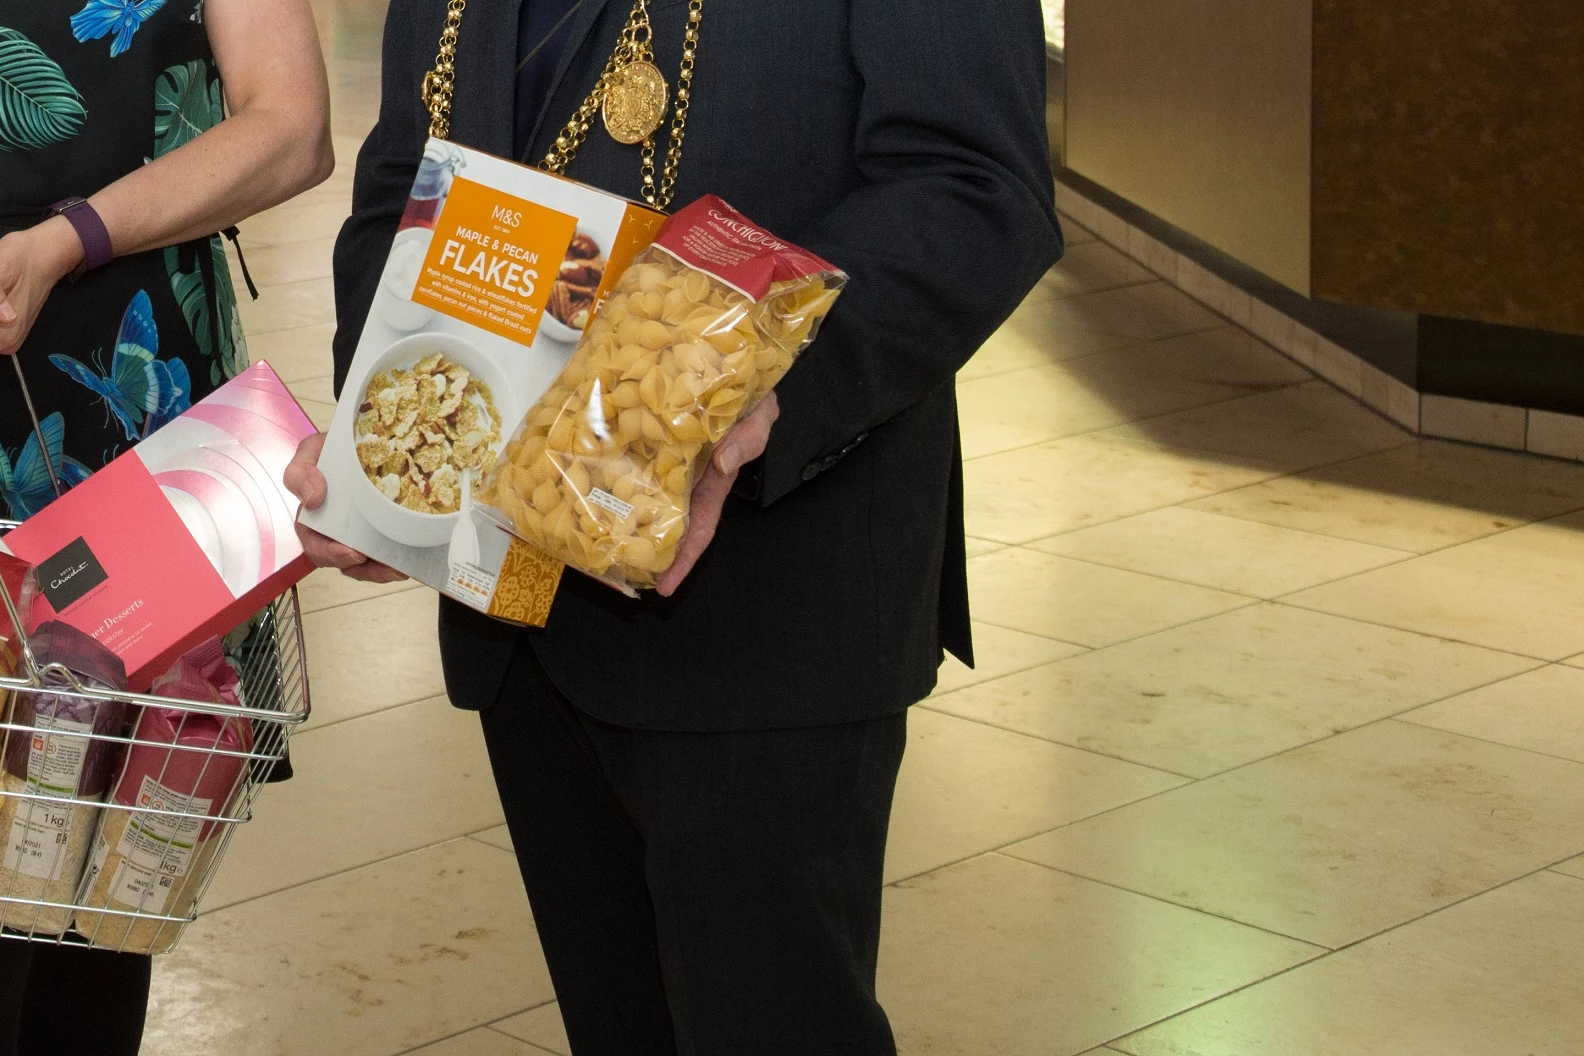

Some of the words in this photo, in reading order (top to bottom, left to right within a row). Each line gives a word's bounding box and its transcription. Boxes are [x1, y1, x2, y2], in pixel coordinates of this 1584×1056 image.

[491, 205, 522, 228] M&S
[706, 221, 733, 240] AUTHENTIC
[456, 226, 490, 247] MAPLE
[492, 239, 499, 250] &
[502, 243, 539, 265] PECAN
[439, 239, 538, 297] FLAKES
[419, 286, 442, 300] cornflakes,
[444, 296, 458, 306] pecan
[468, 304, 483, 316] pieces
[488, 311, 504, 323] flaked
[504, 318, 519, 329] Brazil
[520, 323, 531, 334] nuts
[427, 267, 441, 278] Maple
[441, 274, 455, 283] syrup
[456, 277, 472, 289] coated
[472, 283, 481, 293] rice
[487, 290, 515, 306] wheatflakes
[517, 301, 537, 314] fortified
[431, 280, 441, 288] with
[442, 283, 461, 297] vitamins
[478, 298, 488, 306] with
[489, 303, 506, 315] yogurt
[507, 309, 524, 320] coated
[60, 566, 74, 576] HOTEL
[104, 599, 143, 628] Desserts
